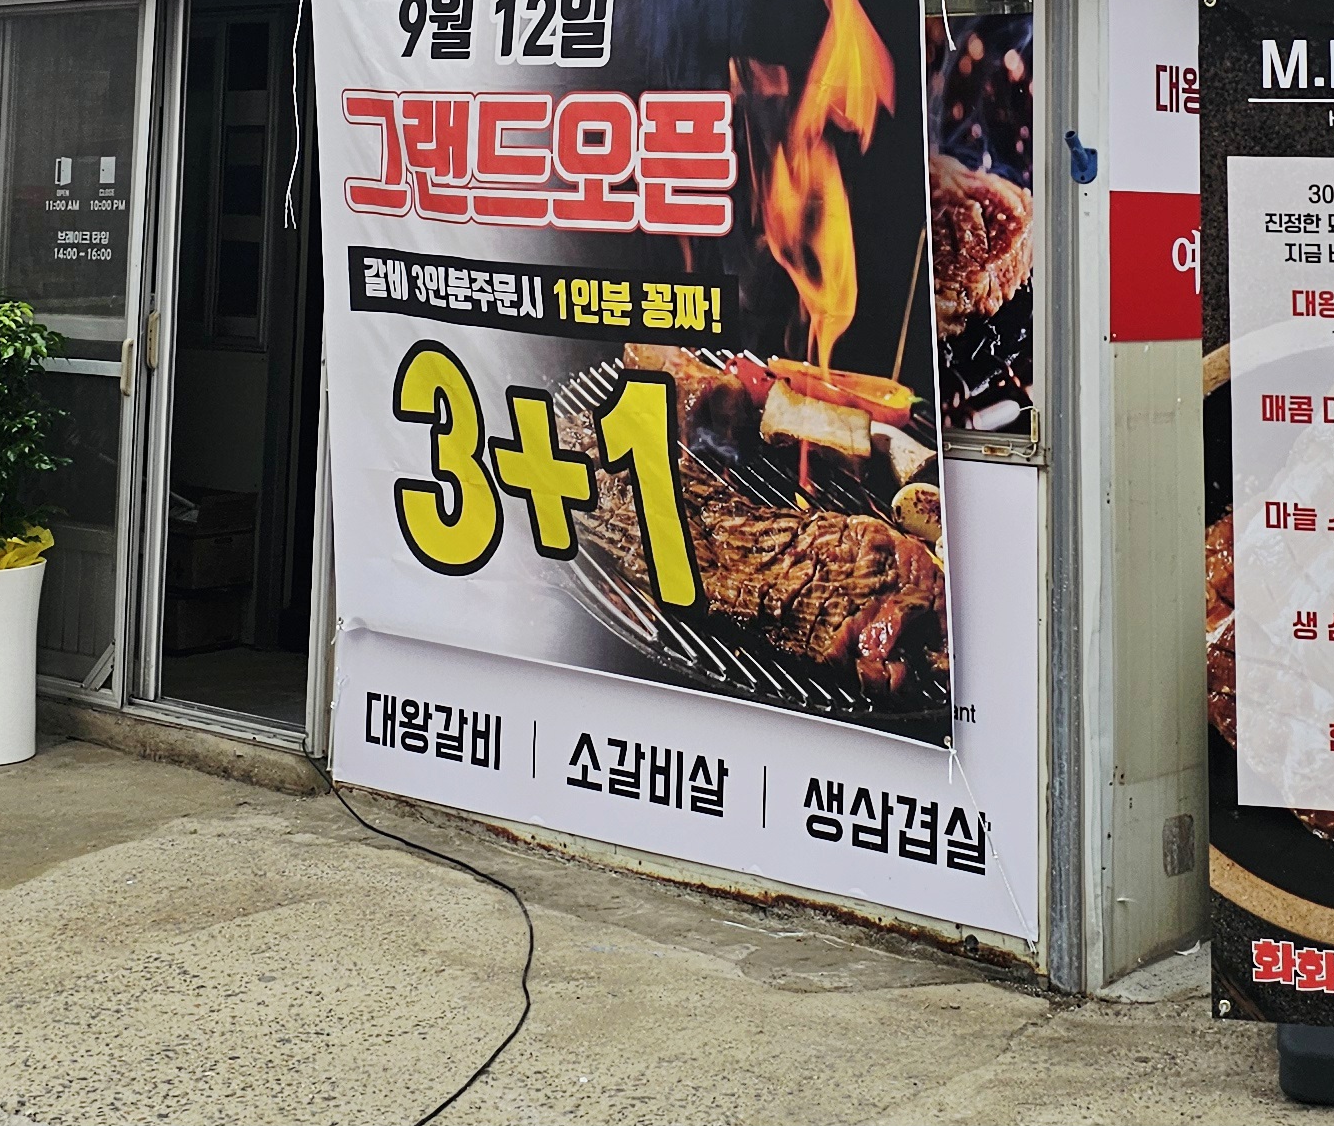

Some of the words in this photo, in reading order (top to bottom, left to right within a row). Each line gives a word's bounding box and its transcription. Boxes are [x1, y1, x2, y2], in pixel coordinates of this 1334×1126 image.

[343, 91, 736, 235] 그랜드오픈
[45, 200, 66, 211] 11:00
[67, 200, 80, 211] AM
[90, 200, 112, 211] 10:00
[113, 200, 126, 211] PM
[57, 230, 91, 244] 브레이크
[91, 231, 110, 245] 타임
[1264, 212, 1323, 236] 진정한
[54, 247, 78, 260] 14:00
[87, 248, 112, 261] 16:00
[1284, 242, 1323, 266] 지금
[363, 257, 409, 300] 갈비
[411, 266, 544, 320] 3인분주문시
[554, 279, 633, 326] 1인분
[641, 282, 722, 334] 꽁짜!
[1261, 394, 1314, 425] 매콤
[392, 339, 705, 614] 3+1
[1265, 500, 1318, 532] 마늘
[1291, 610, 1319, 642] 생
[365, 692, 502, 771] 대왕갈비
[567, 731, 729, 818] 소갈비살
[803, 776, 992, 876] 생삼겹살
